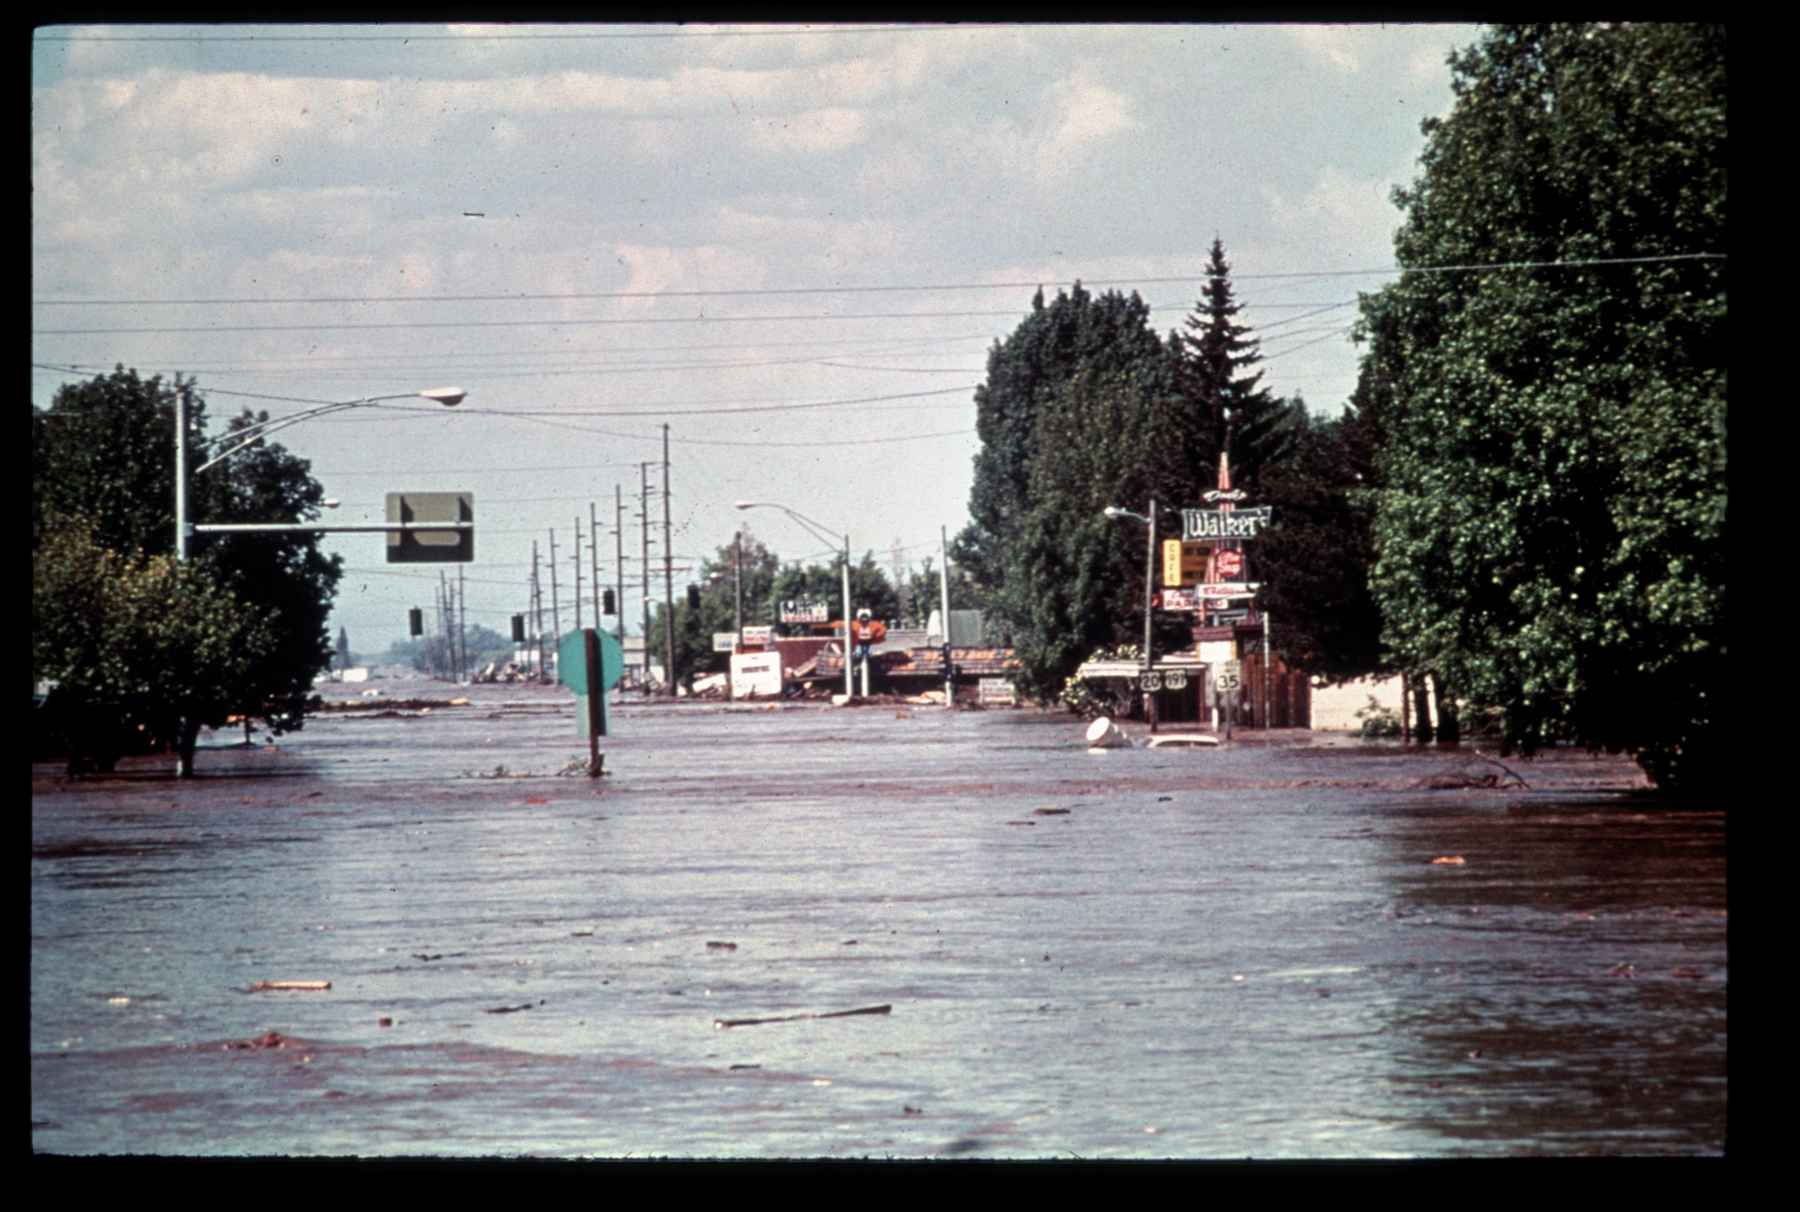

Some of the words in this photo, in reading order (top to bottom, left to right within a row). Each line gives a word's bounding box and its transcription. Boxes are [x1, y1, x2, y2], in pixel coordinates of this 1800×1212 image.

[1190, 509, 1266, 537] Walker's
[1143, 675, 1158, 688] 20
[1219, 674, 1239, 689] 35
